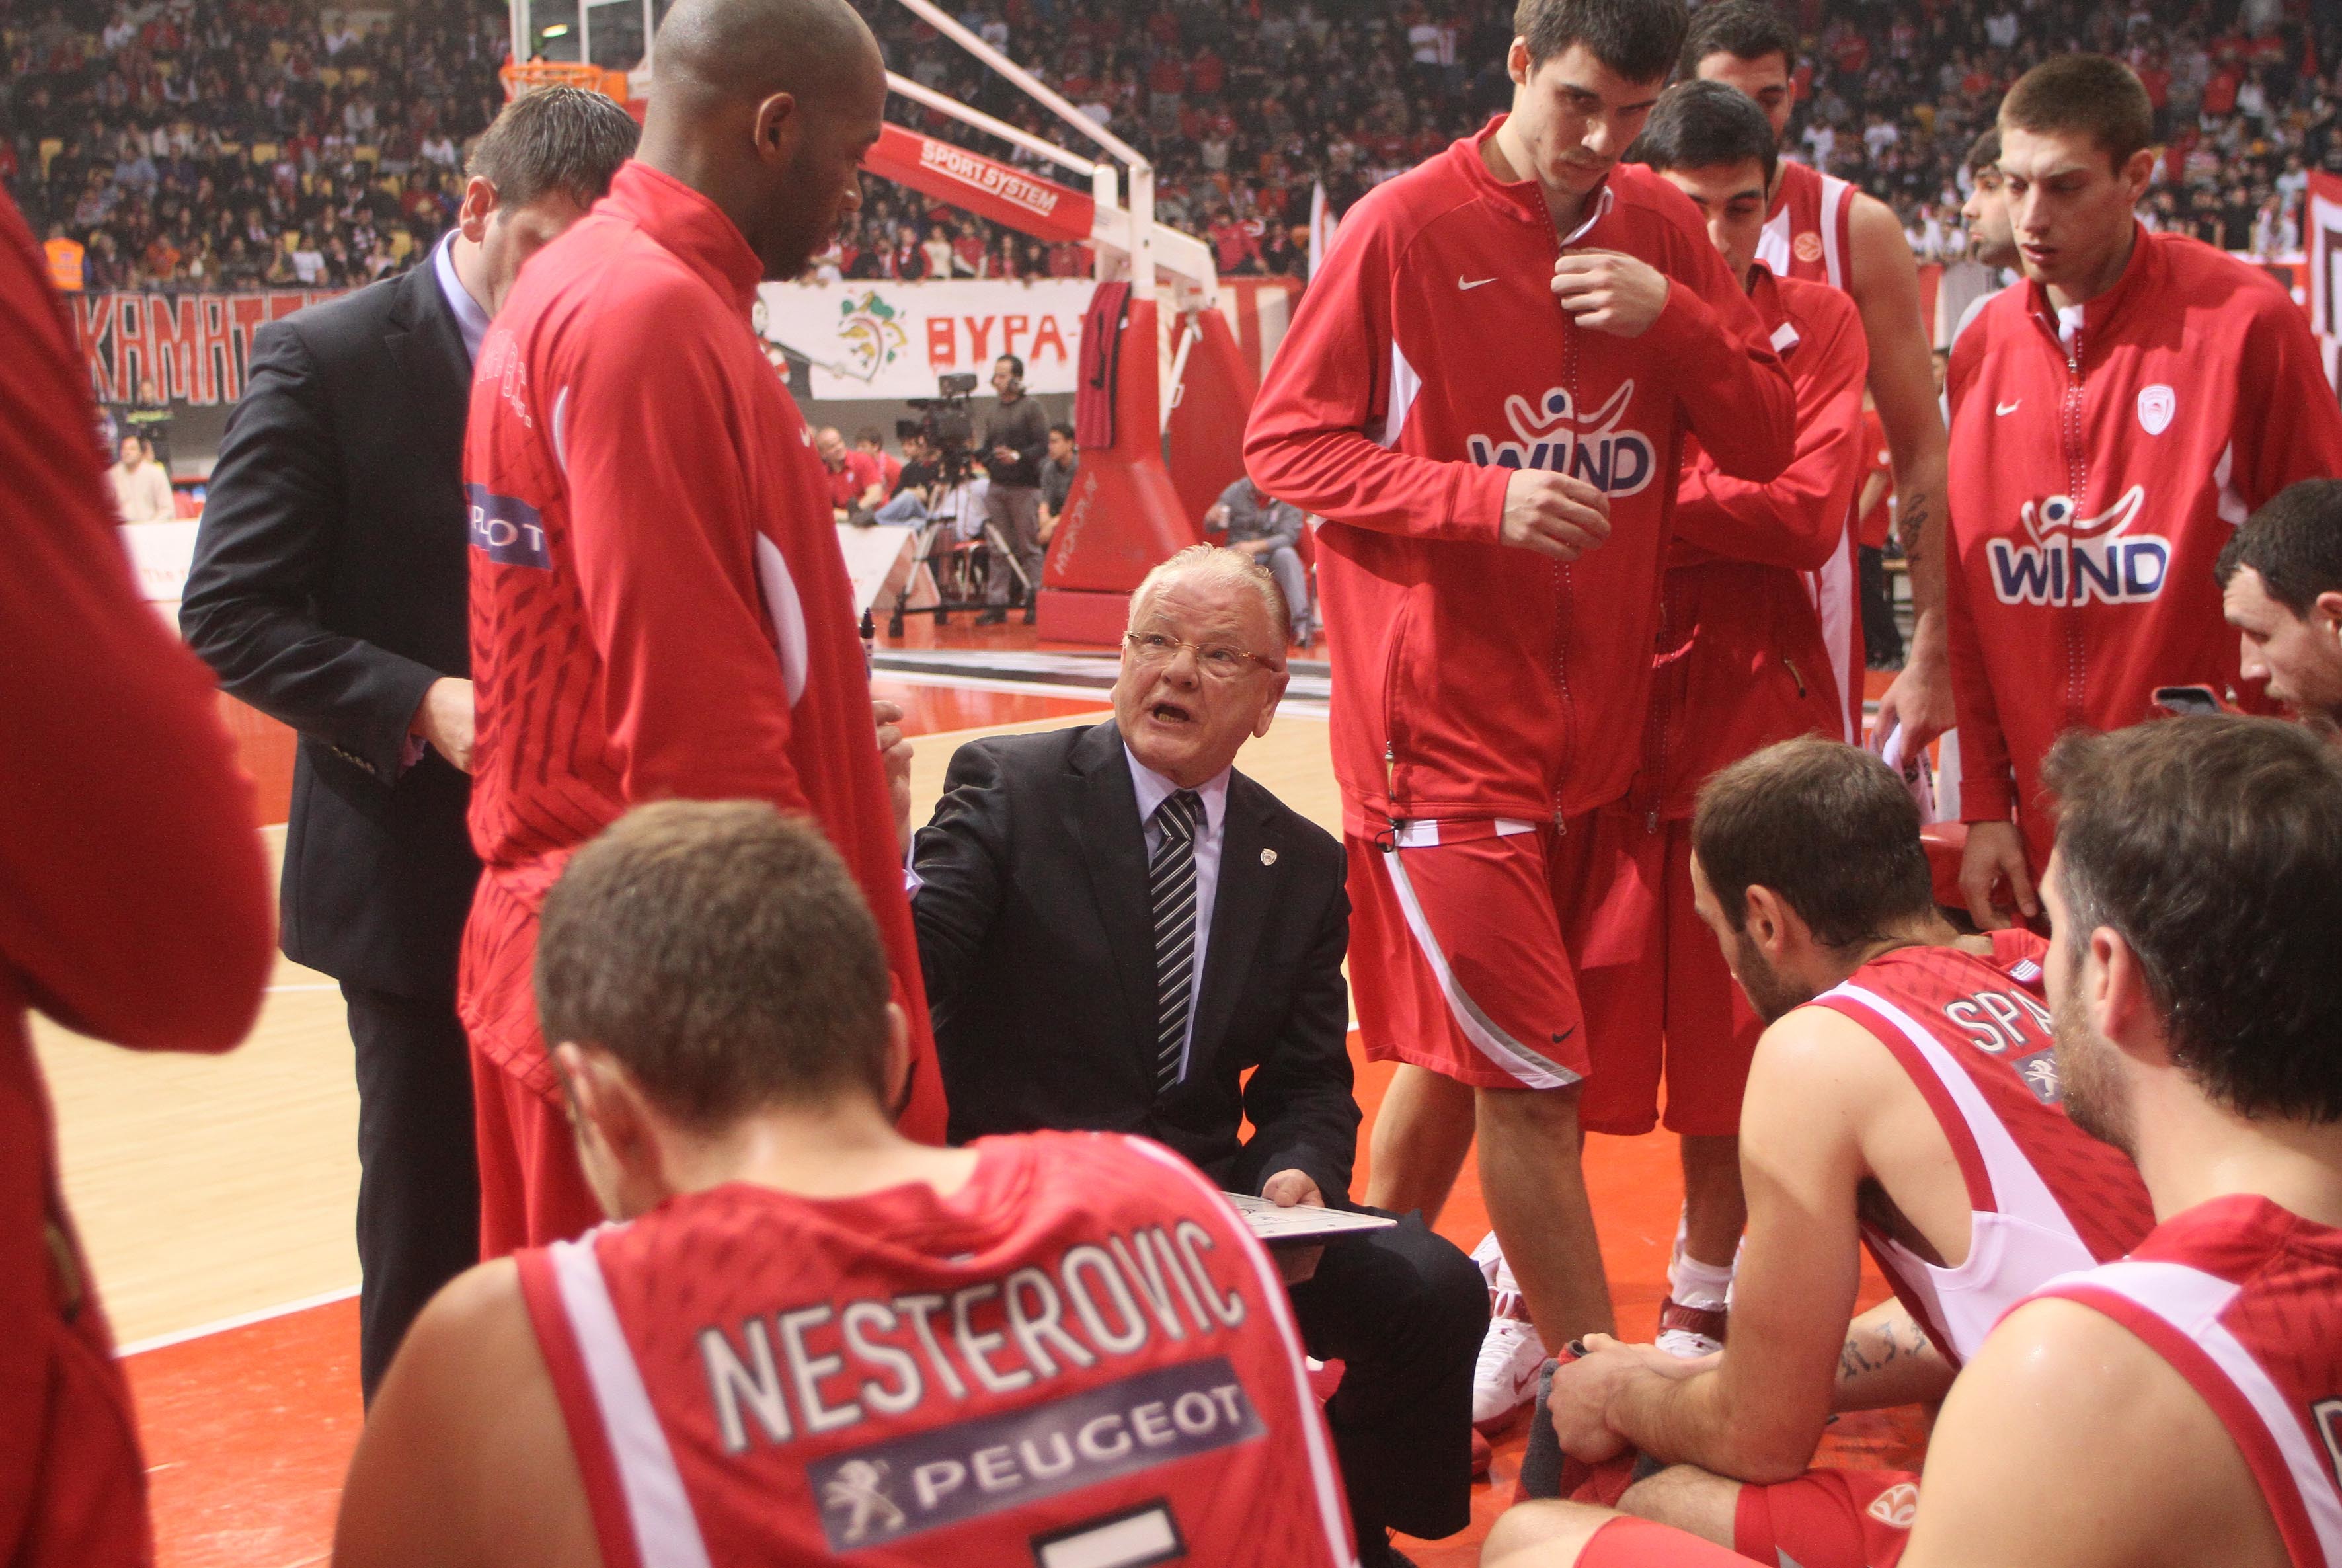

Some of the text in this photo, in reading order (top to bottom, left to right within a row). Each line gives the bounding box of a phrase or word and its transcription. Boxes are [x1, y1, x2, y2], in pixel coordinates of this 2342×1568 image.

[921, 139, 1059, 212] SPORT SYSTEM
[1987, 535, 2171, 605] WIND
[698, 1220, 1246, 1454] NESTEROVIC
[914, 1385, 1245, 1510] PEUGEOT
